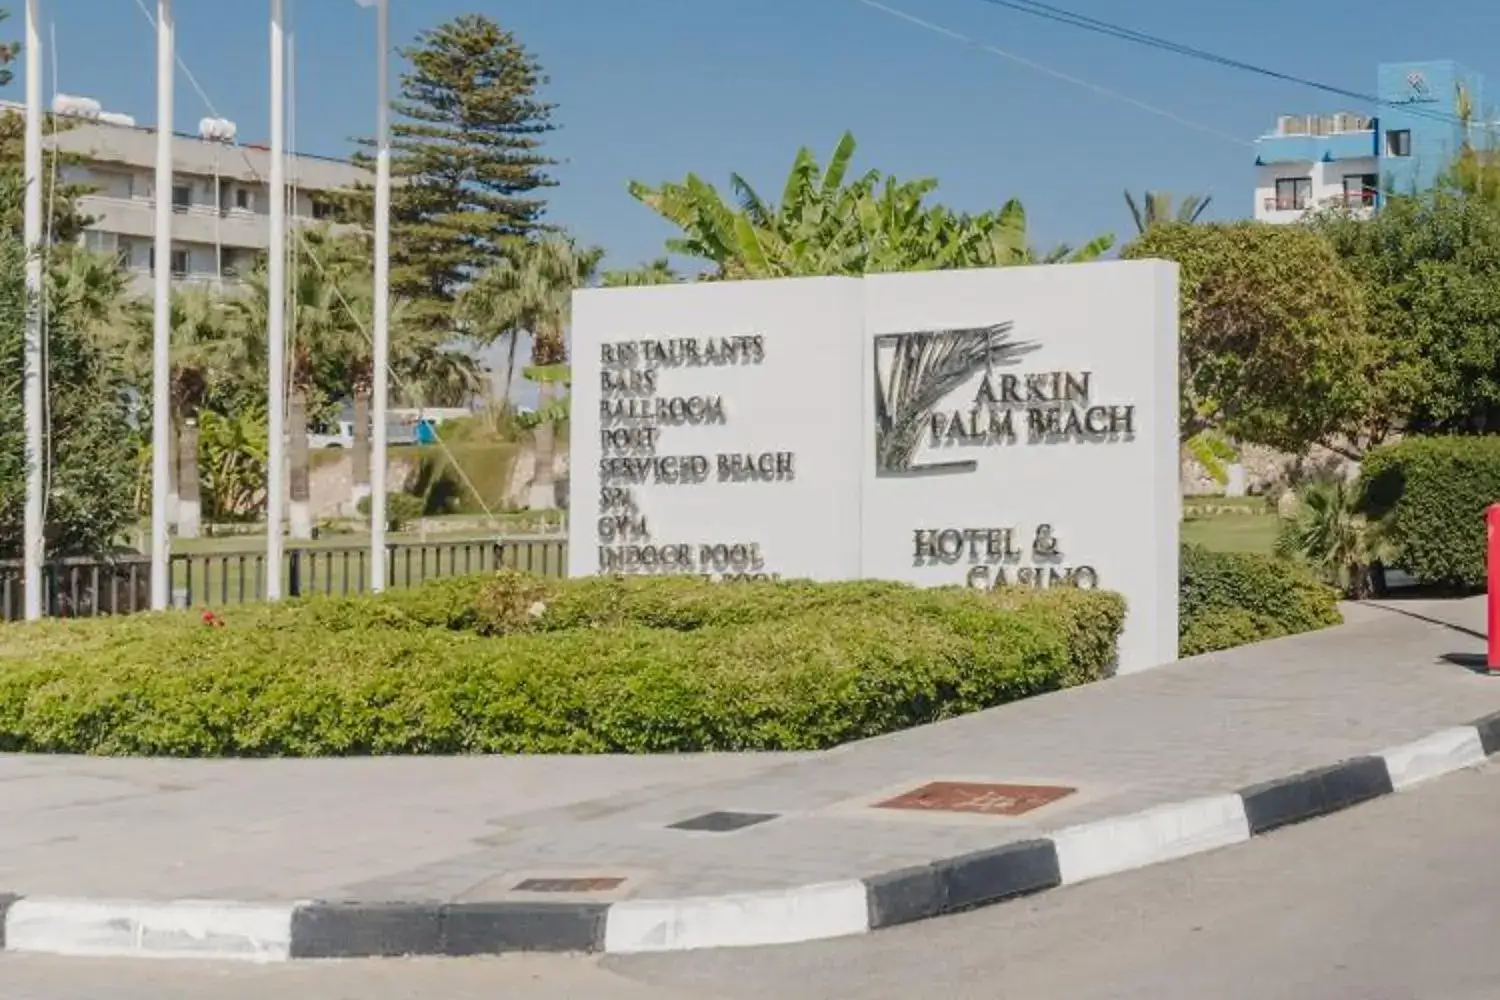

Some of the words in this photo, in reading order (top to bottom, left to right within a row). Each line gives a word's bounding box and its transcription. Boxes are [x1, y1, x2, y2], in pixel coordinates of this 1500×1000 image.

[600, 335, 765, 364] RESTAURANTS
[600, 369, 656, 394] BARS
[973, 371, 1092, 405] ARKIN
[600, 396, 725, 424] BALLROOM
[930, 409, 1016, 442] PALM
[1028, 405, 1137, 439] BEACH
[716, 452, 793, 478] BEACH
[913, 528, 1021, 561] HOTEL
[1032, 523, 1061, 560] &
[599, 545, 693, 570] INDOOR
[699, 543, 764, 569] POOL
